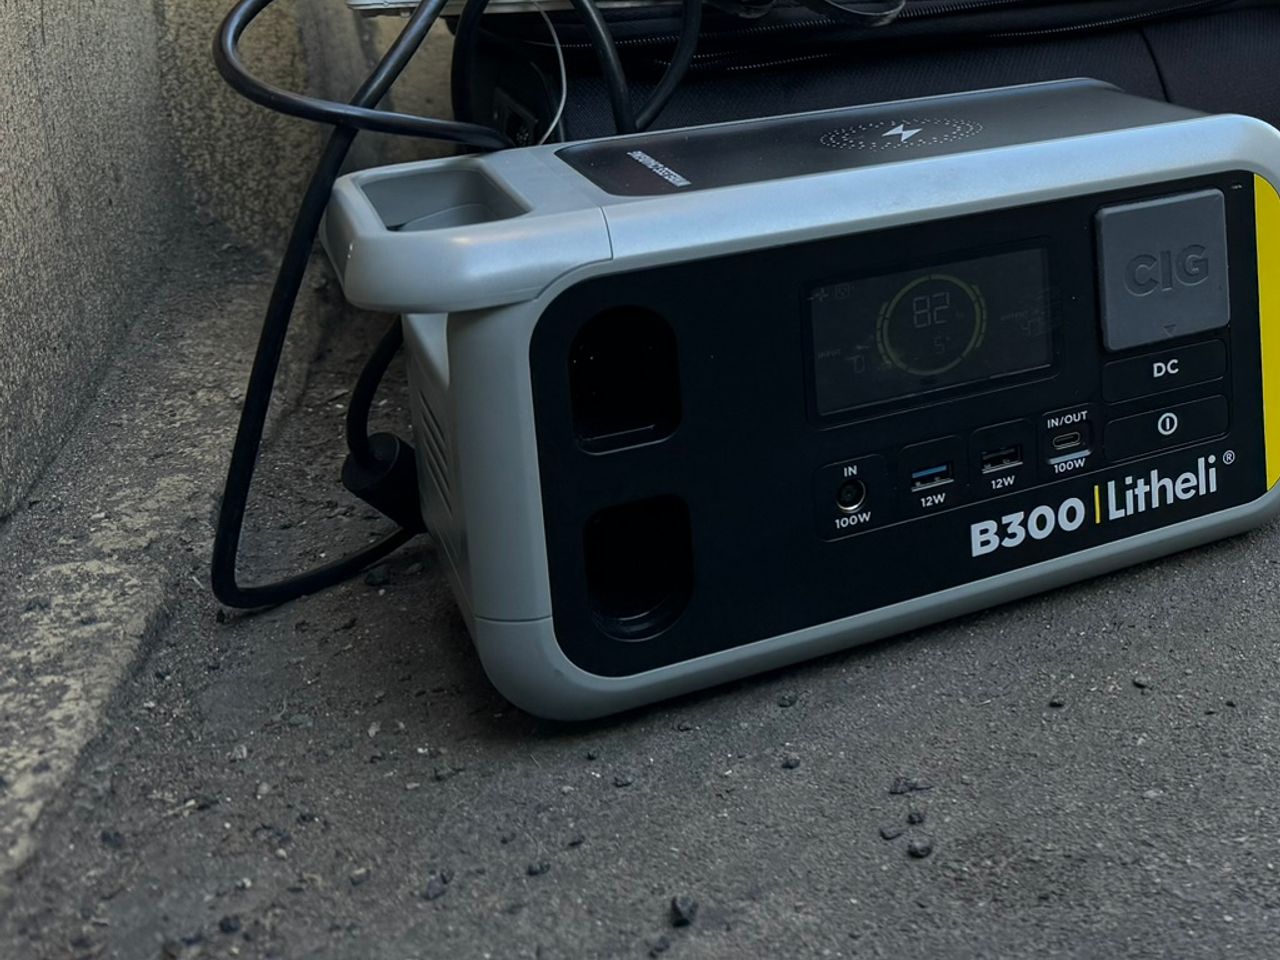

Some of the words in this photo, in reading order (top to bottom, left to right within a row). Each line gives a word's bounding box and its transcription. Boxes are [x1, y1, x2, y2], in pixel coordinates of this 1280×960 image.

[1123, 244, 1209, 297] CIG
[913, 292, 950, 329] 82
[1153, 359, 1179, 377] DC
[1047, 411, 1088, 429] IN/OUT
[843, 465, 858, 477] IN
[1054, 457, 1086, 474] 100W
[991, 475, 1015, 490] 12W
[920, 492, 946, 507] 12W
[835, 511, 872, 529] 100W
[970, 497, 1086, 557] B300
